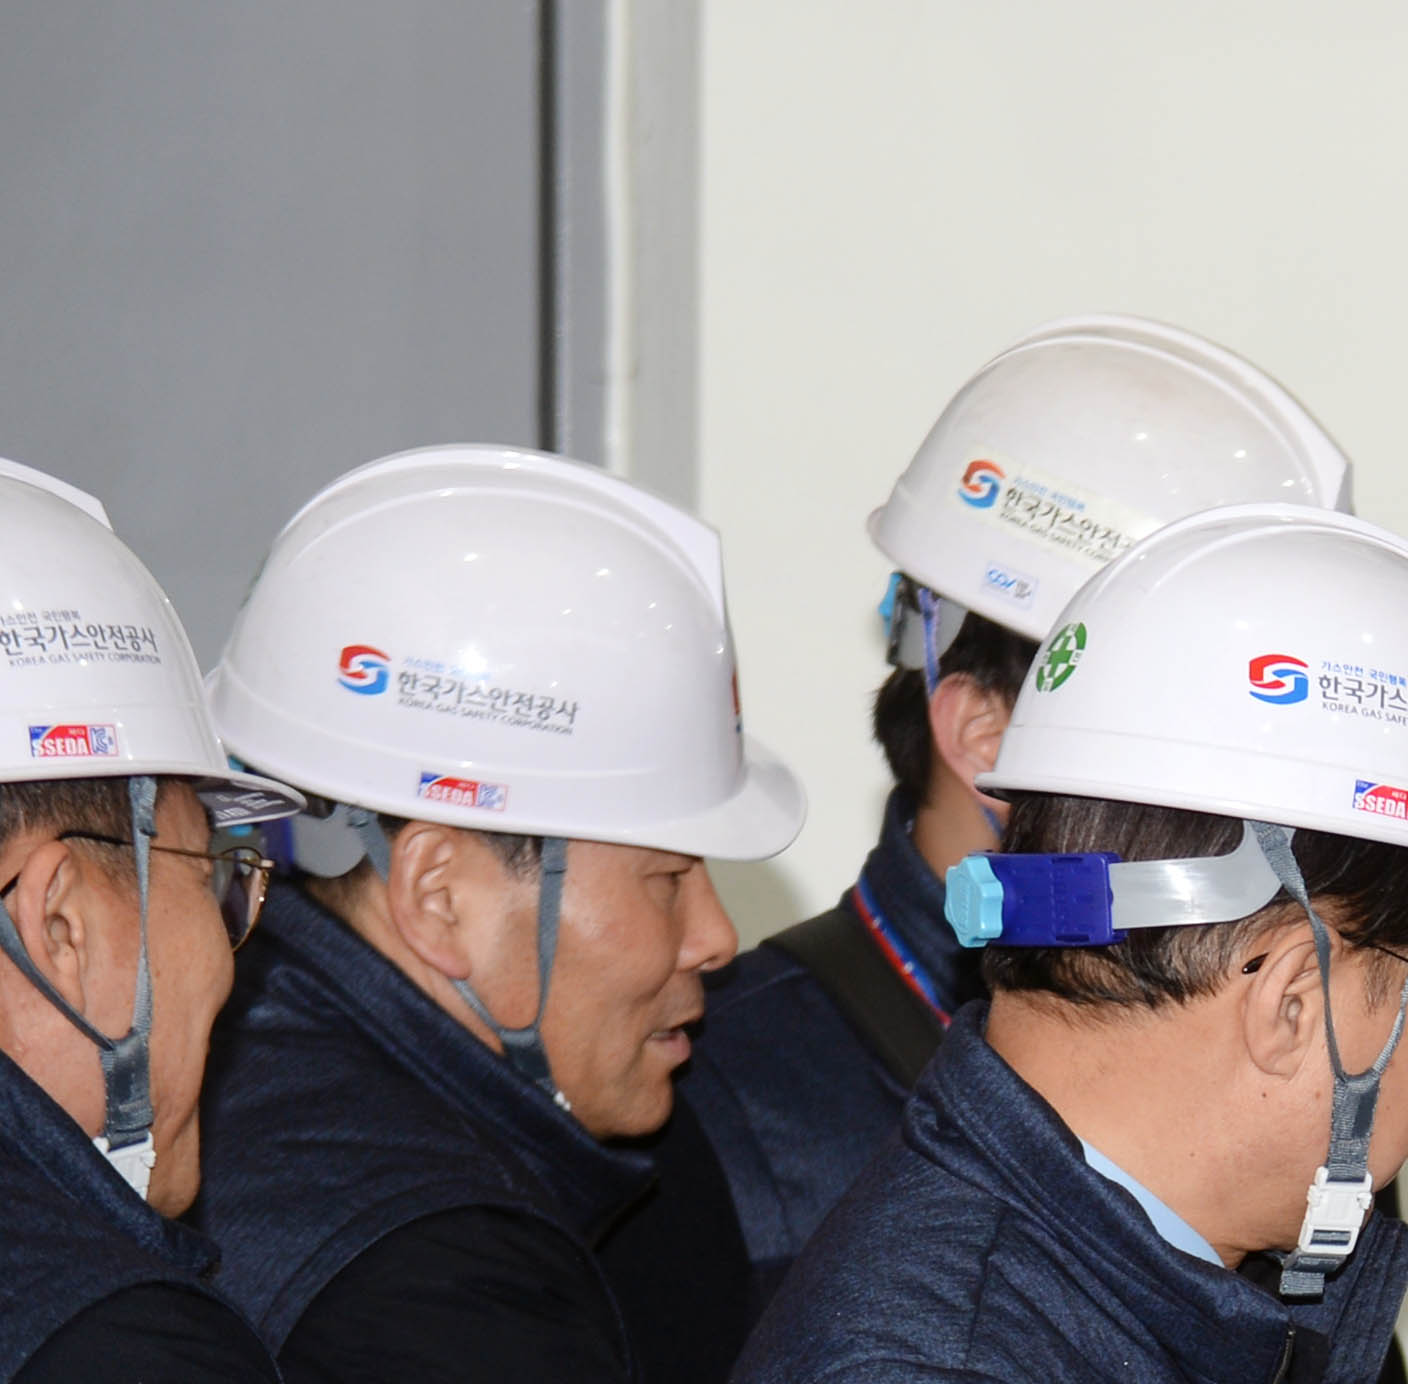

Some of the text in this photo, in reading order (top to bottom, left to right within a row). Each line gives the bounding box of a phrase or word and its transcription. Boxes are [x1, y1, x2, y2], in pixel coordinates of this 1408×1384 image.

[0, 623, 159, 656] 한국가스안전공사
[49, 654, 71, 665] GAS
[398, 670, 580, 725] 한국가스안전공사
[1322, 701, 1359, 715] KOREA
[1360, 707, 1383, 720] GAS
[32, 736, 91, 756] SSEDA
[1353, 791, 1407, 820] SSEDA
